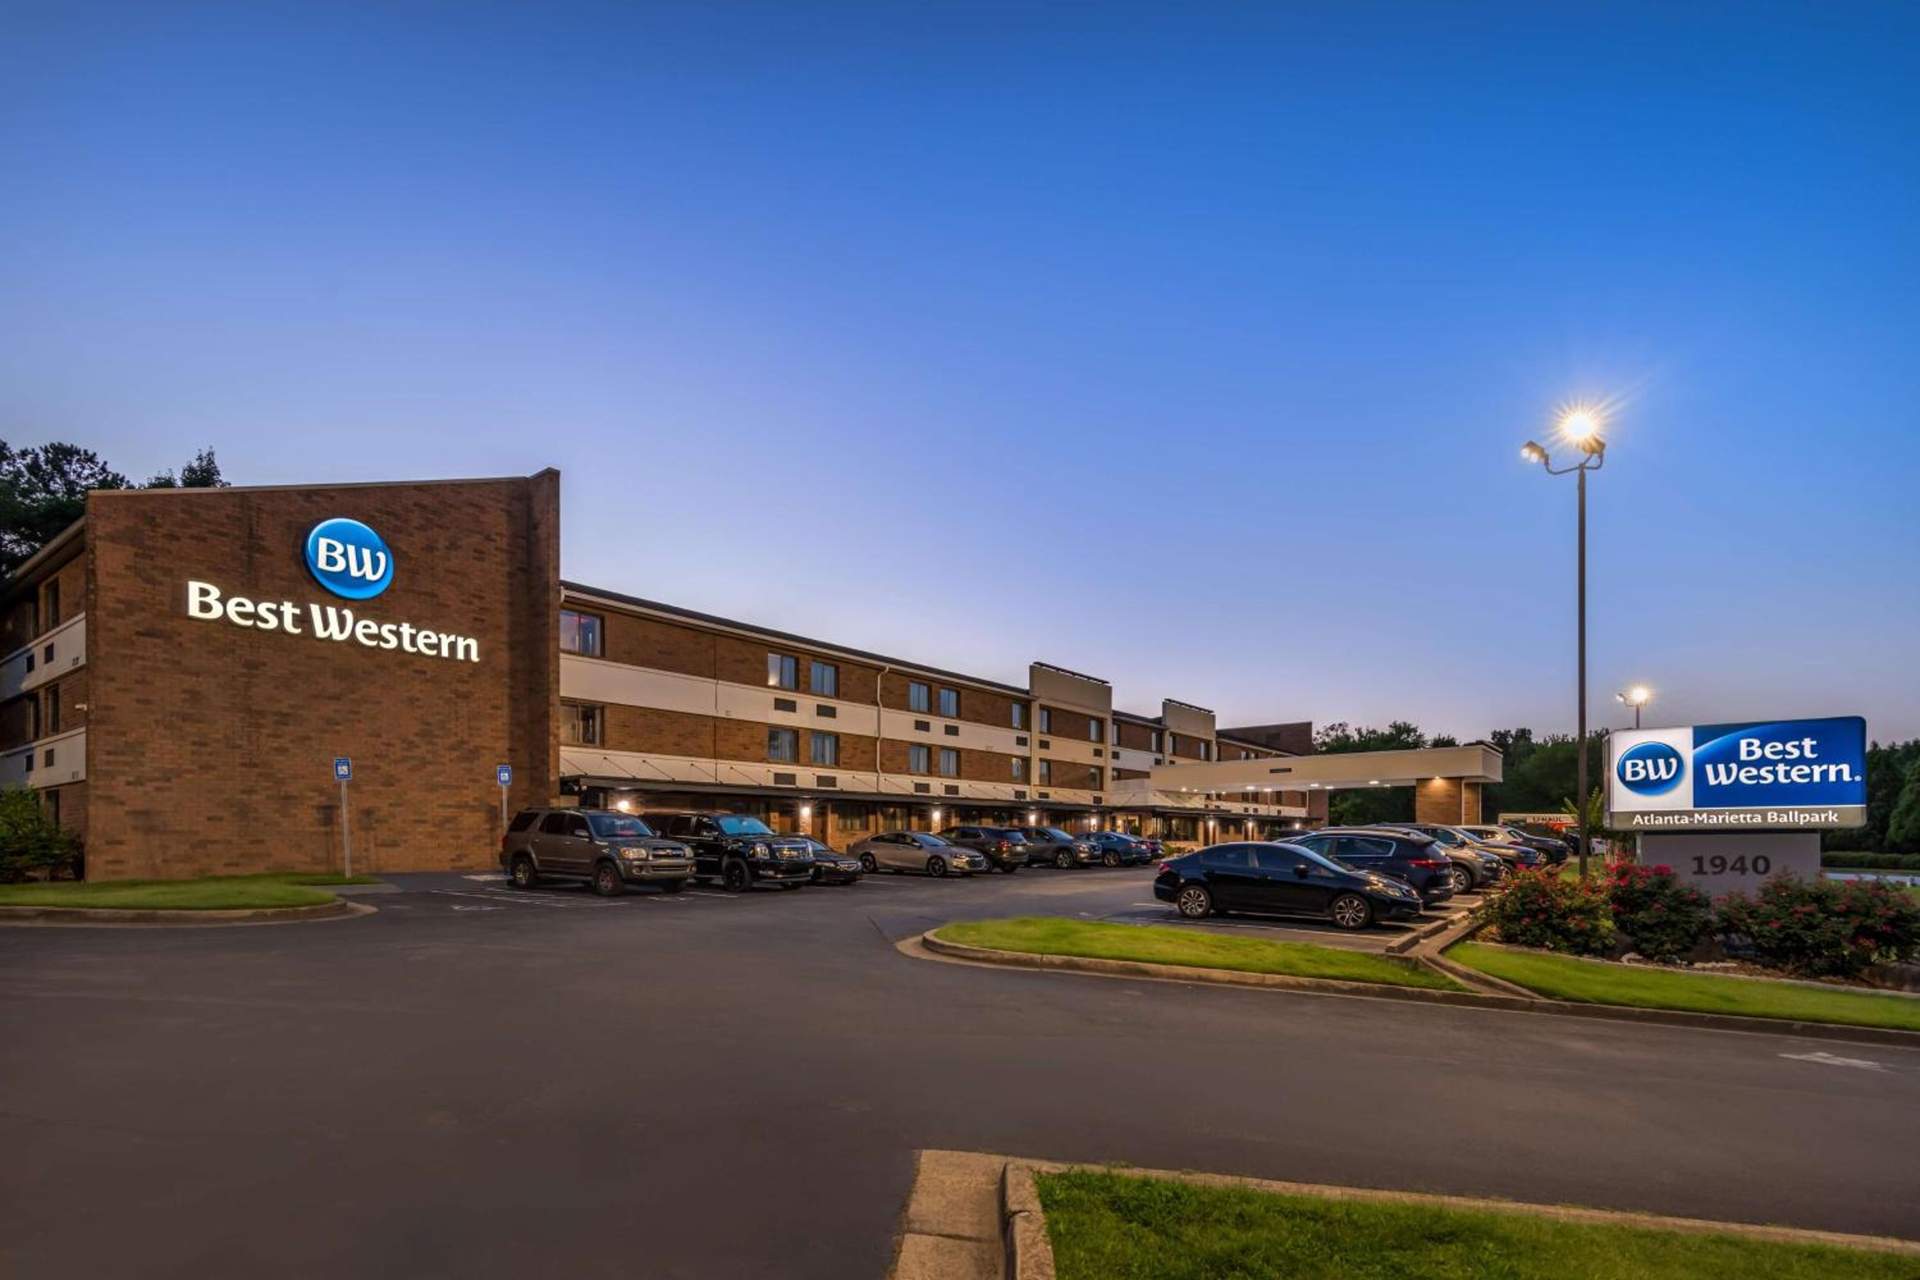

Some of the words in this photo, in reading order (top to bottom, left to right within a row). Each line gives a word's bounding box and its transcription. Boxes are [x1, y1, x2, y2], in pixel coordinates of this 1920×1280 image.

[316, 536, 387, 582] BW
[187, 580, 302, 635] Best
[310, 603, 480, 663] Western
[1739, 737, 1818, 761] Best
[1624, 757, 1678, 782] BW
[1632, 811, 1762, 826] Atlanta-Marietta
[1766, 809, 1839, 824] Ballpark
[1691, 854, 1771, 877] 1940
